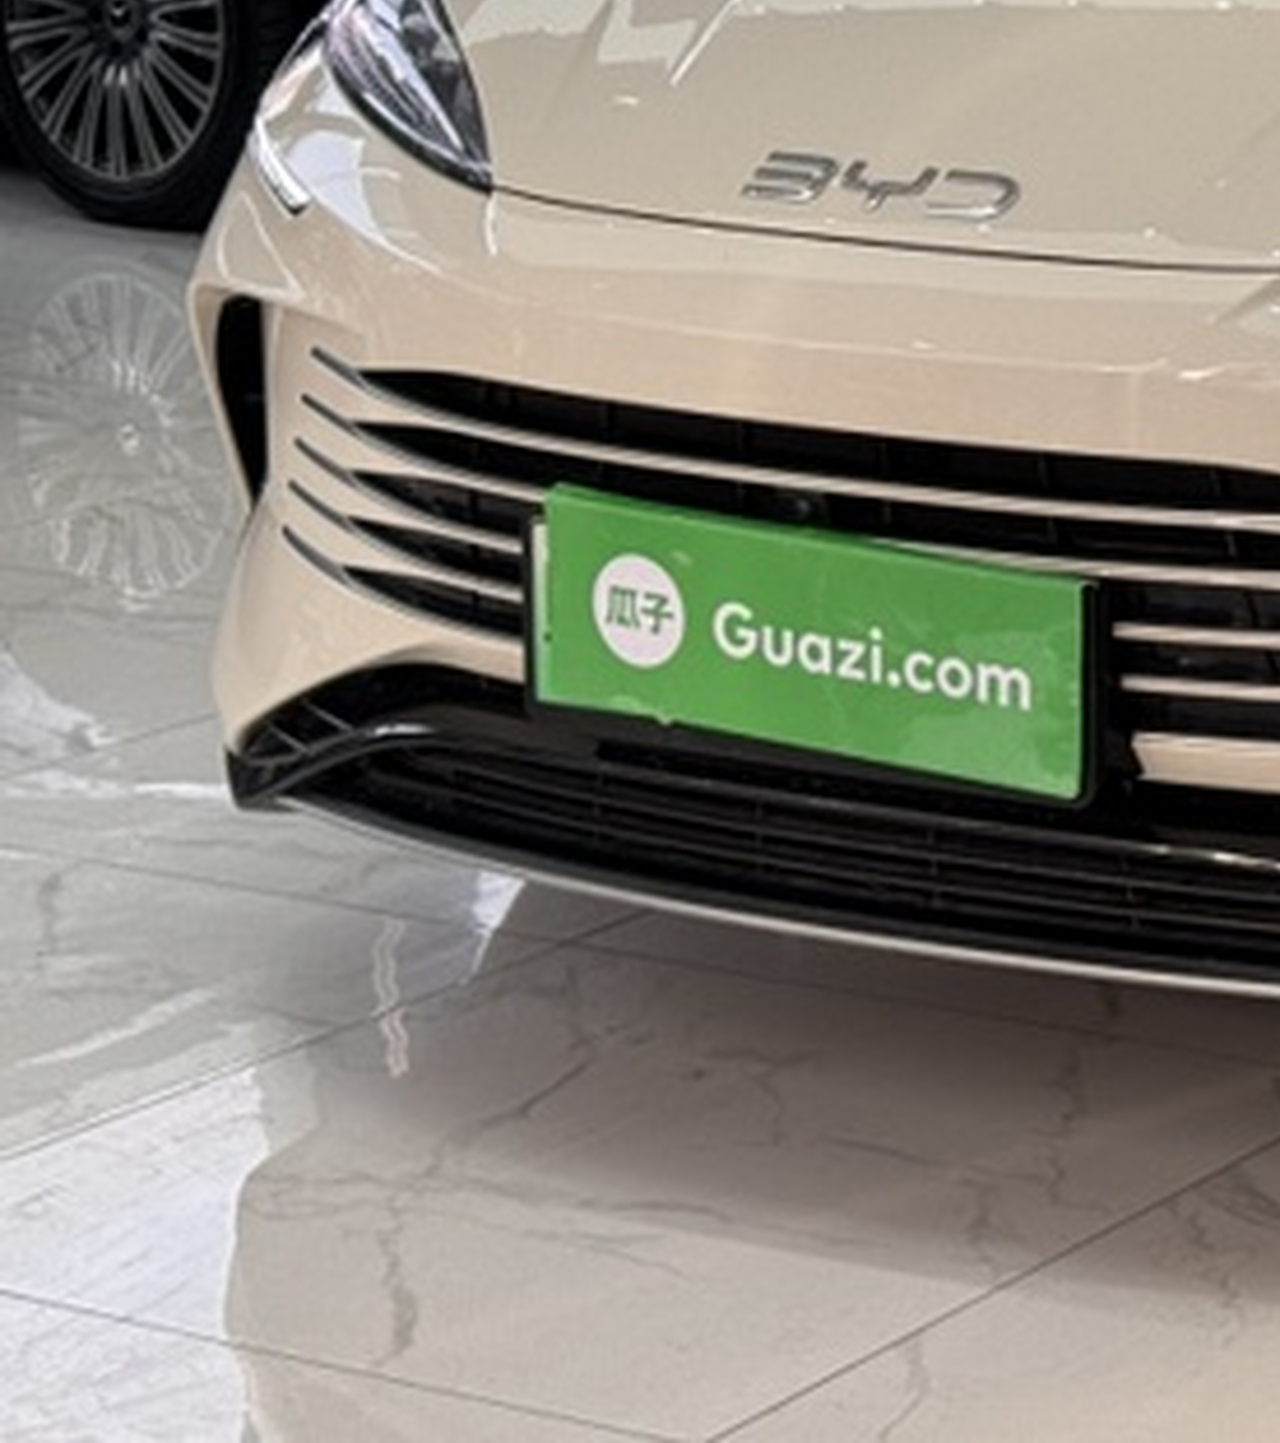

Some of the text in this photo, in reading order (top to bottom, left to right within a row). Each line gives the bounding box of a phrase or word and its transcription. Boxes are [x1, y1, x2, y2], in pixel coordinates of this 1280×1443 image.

[741, 151, 1021, 220] BYD
[604, 584, 675, 635] 瓜子
[713, 601, 1031, 711] Guazi.com
